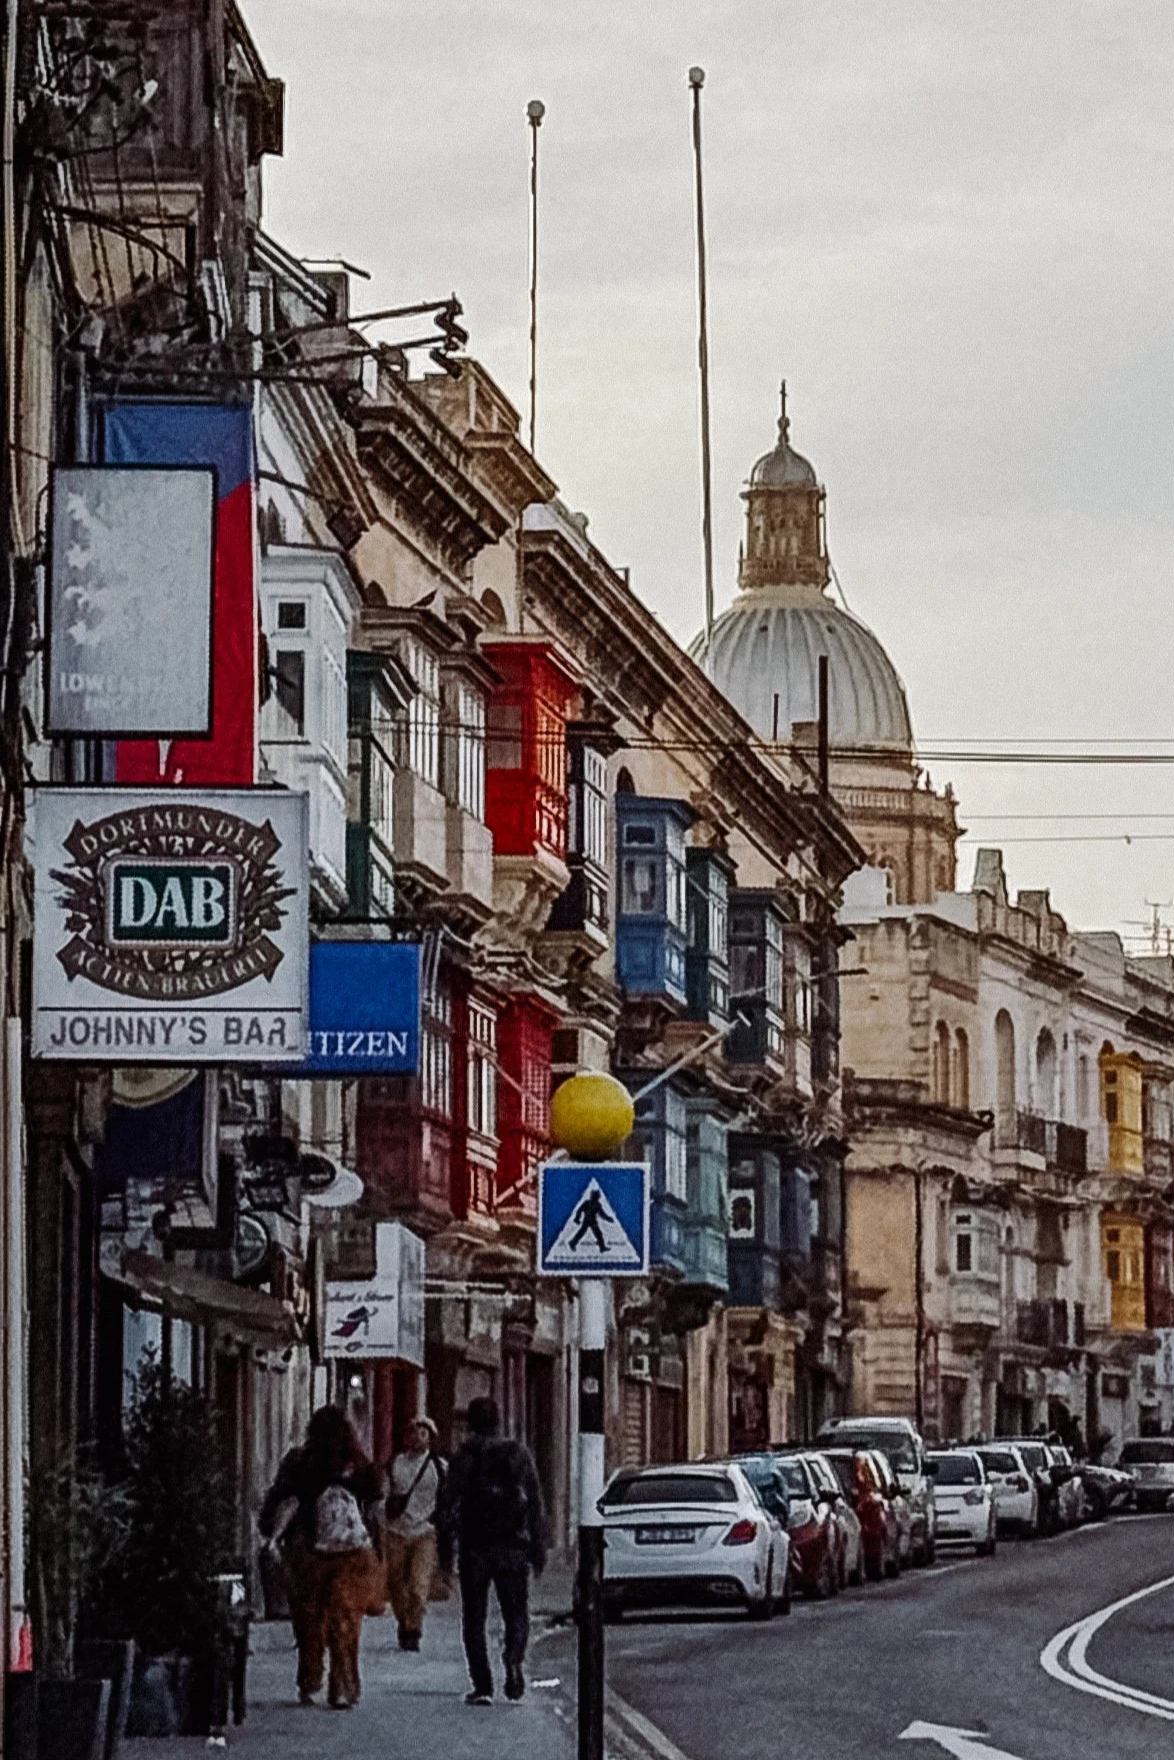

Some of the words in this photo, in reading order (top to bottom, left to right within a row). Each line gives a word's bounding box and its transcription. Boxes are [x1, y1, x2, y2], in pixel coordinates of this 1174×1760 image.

[79, 810, 265, 856] DORTMUNDER
[119, 876, 226, 928] DAB
[50, 1016, 207, 1045] JOHNNY'S
[223, 1016, 286, 1046] BAR
[306, 1030, 409, 1056] ITIZEN
